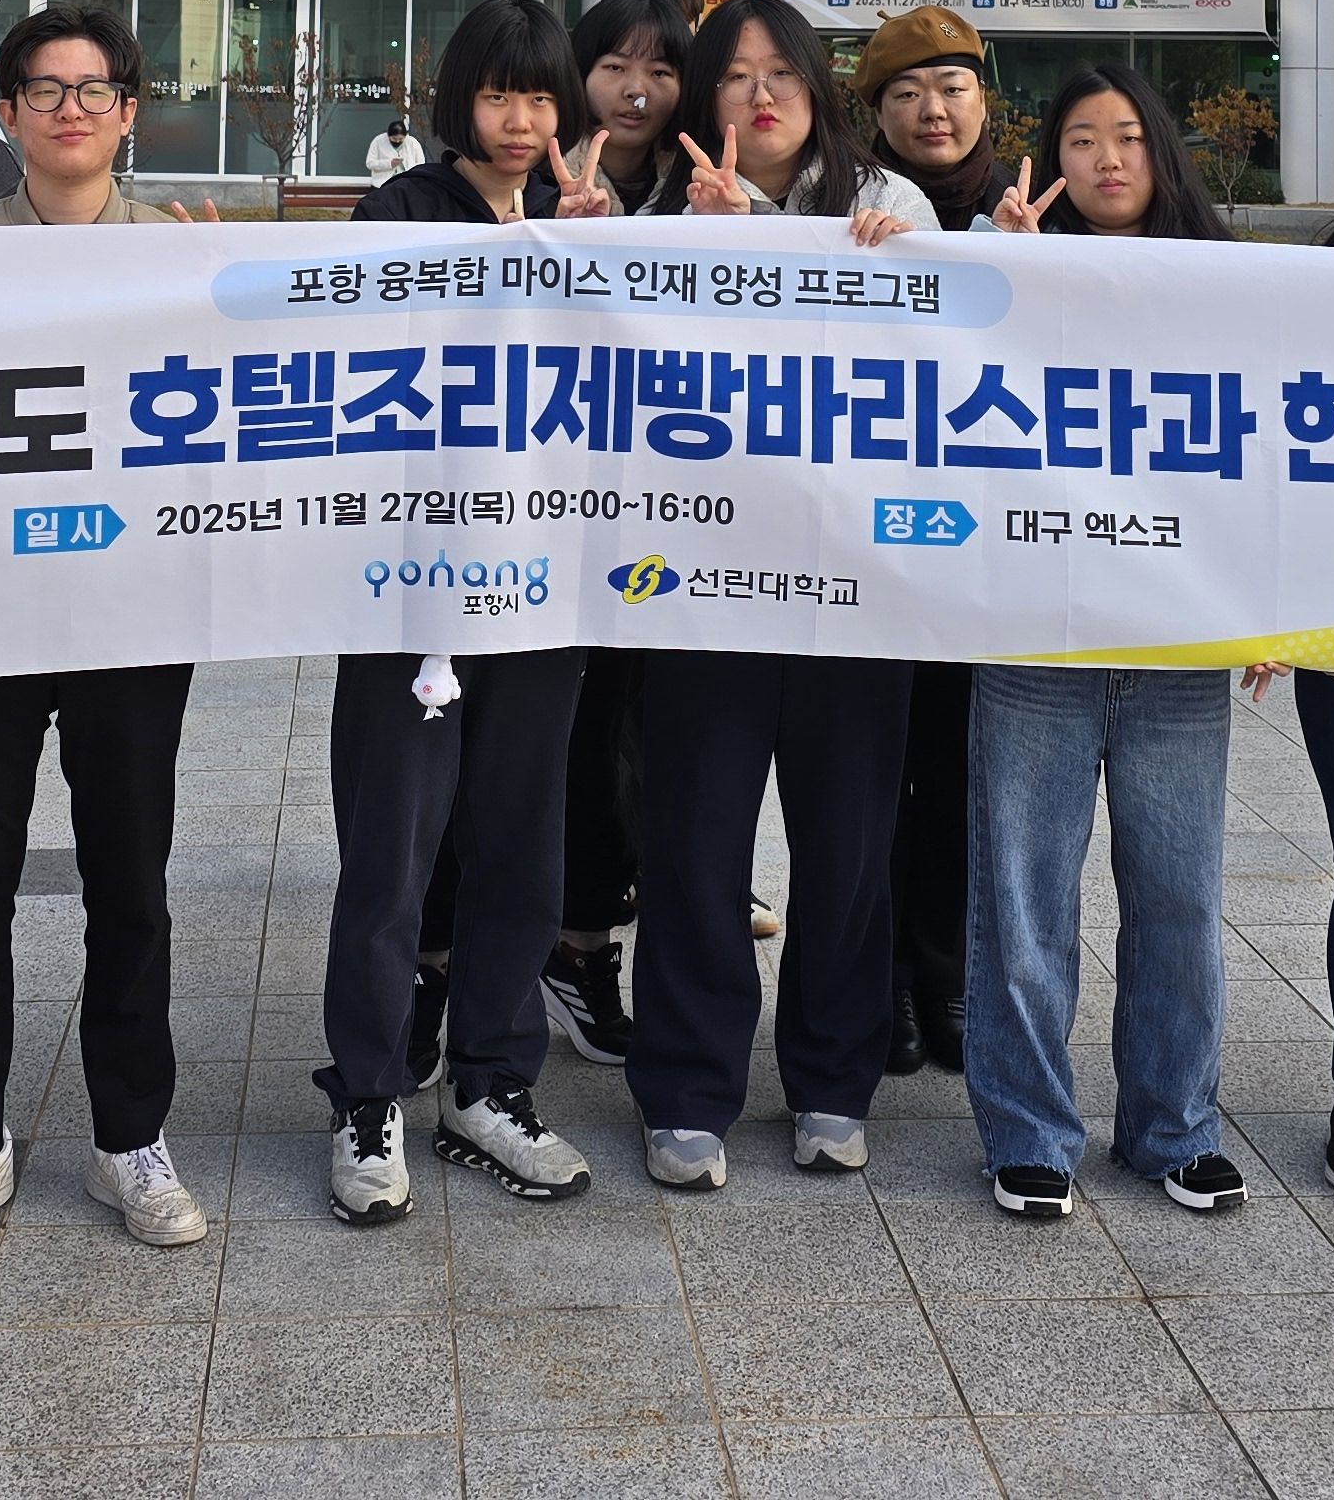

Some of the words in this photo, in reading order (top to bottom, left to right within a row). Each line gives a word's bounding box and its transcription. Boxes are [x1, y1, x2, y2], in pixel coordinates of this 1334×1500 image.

[287, 263, 367, 304] 포항
[376, 256, 489, 301] 융복합
[501, 255, 613, 298] 마이스
[623, 261, 697, 305] 인재
[709, 266, 783, 308] 양성
[795, 269, 941, 315] 프로그램
[121, 344, 1257, 480] 호텔조리제빵바리스타과
[24, 509, 104, 548] 일시
[156, 496, 284, 537] 2025년
[298, 492, 368, 528] 11월
[379, 489, 516, 526] 27일(목)
[526, 490, 735, 526] 09:00~16:00
[883, 503, 958, 540] 장소
[1006, 509, 1072, 545] 대구
[1083, 511, 1182, 549] 엑스코
[463, 593, 520, 616] 포항시
[687, 567, 860, 607] 선린대학교
